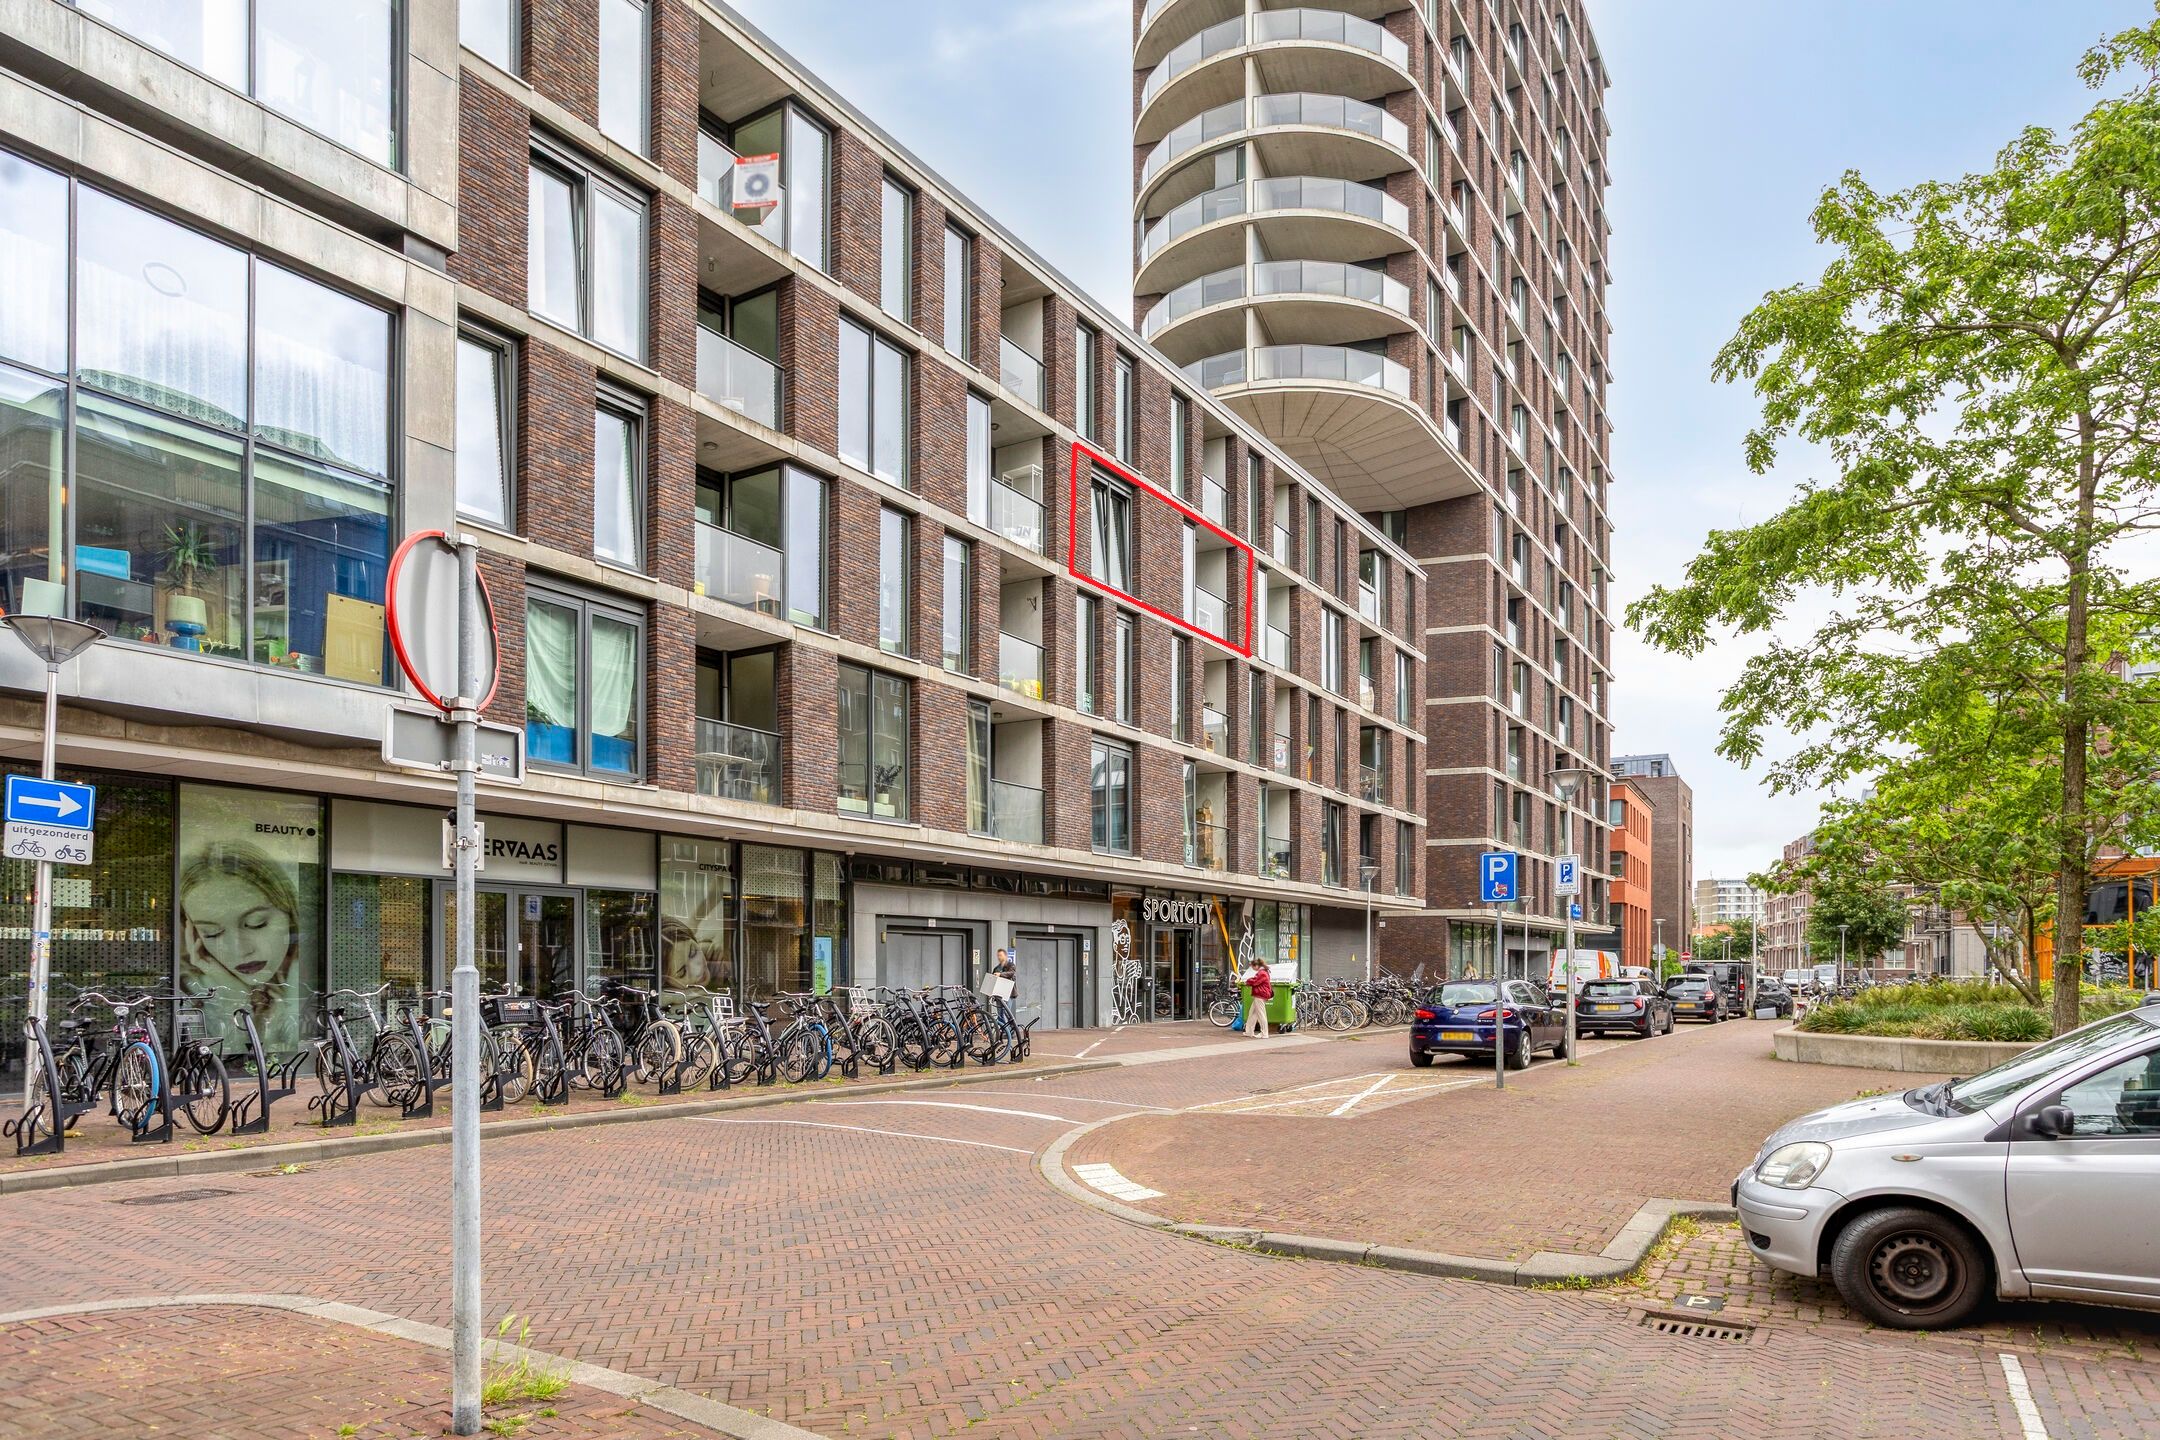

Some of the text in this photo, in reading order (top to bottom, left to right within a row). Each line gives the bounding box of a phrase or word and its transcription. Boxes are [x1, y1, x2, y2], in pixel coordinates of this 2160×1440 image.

[12, 825, 89, 841] uitgezonderd
[255, 823, 304, 836] BEAUTY
[699, 863, 727, 872] CITYSPA
[1489, 857, 1508, 881] P
[1563, 864, 1570, 875] P
[1686, 1295, 1711, 1307] P
